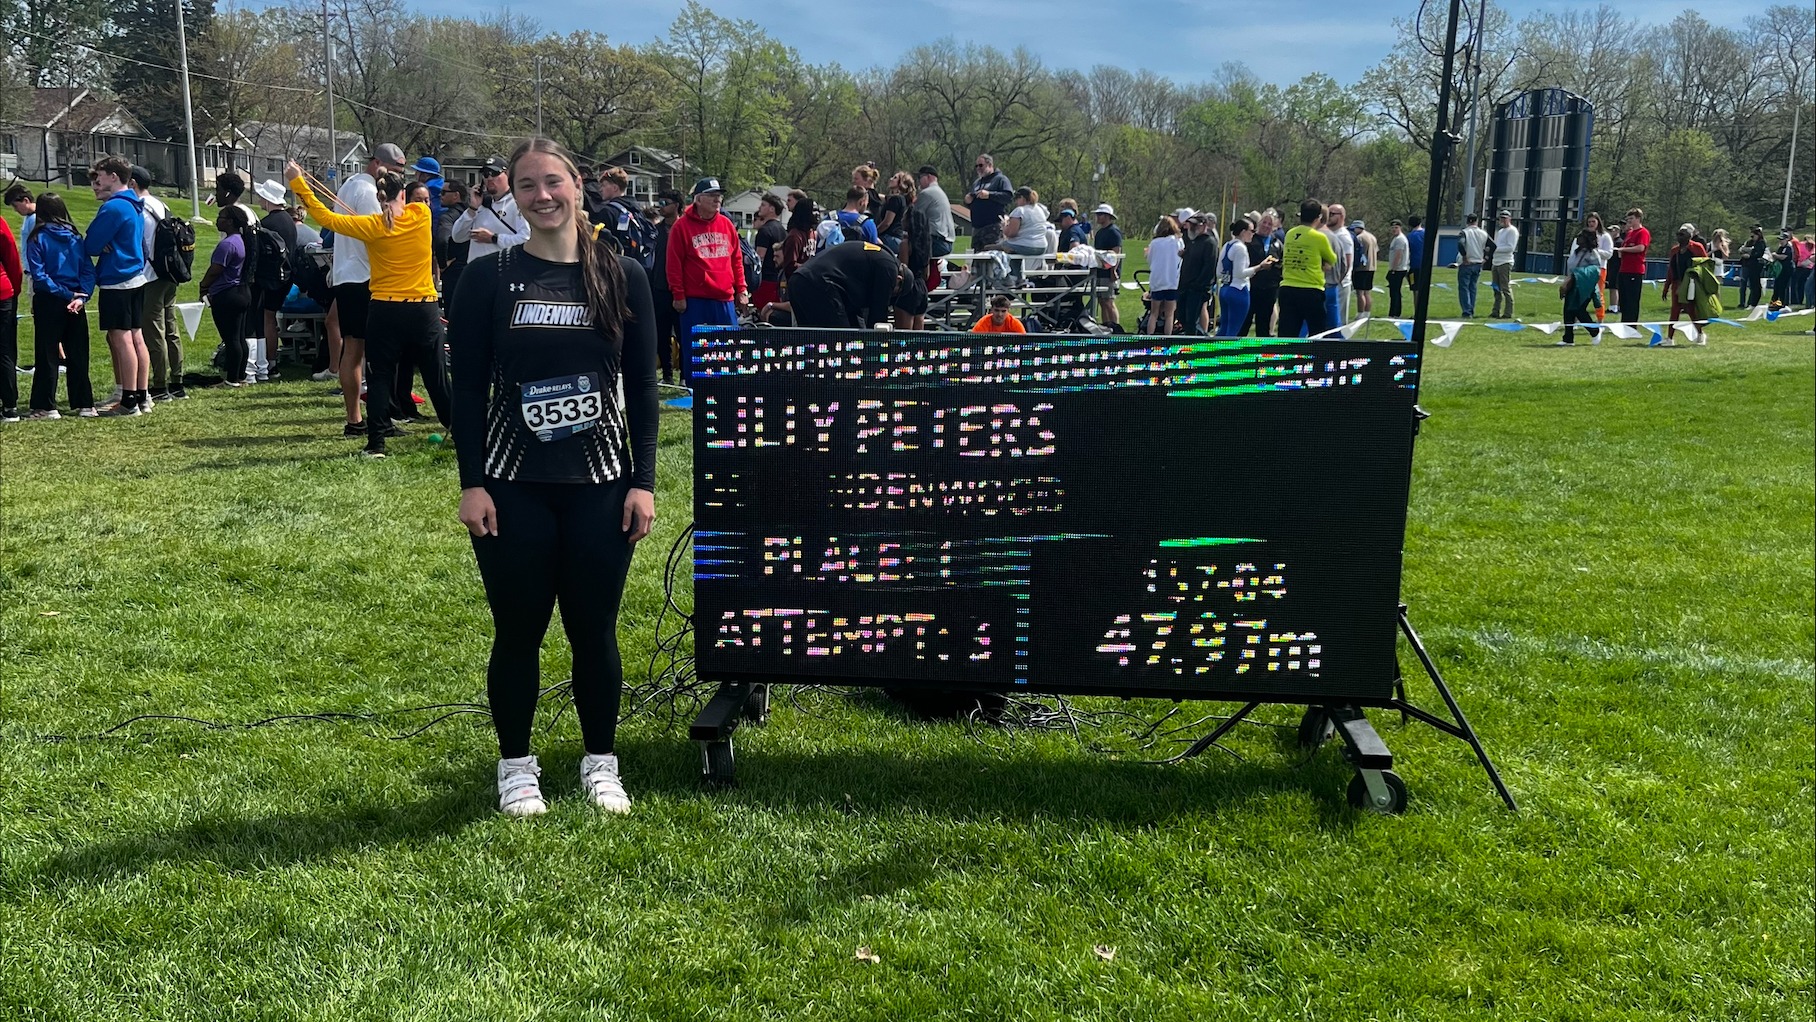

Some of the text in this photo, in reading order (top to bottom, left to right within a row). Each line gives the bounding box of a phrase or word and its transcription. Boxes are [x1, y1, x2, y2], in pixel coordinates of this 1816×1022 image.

[514, 303, 594, 326] LINDENWOO
[529, 383, 572, 396] Drake RELAYS
[527, 395, 599, 427] 3533
[706, 396, 1055, 456] LILLY PETERS
[1096, 611, 1321, 679] 47.97m
